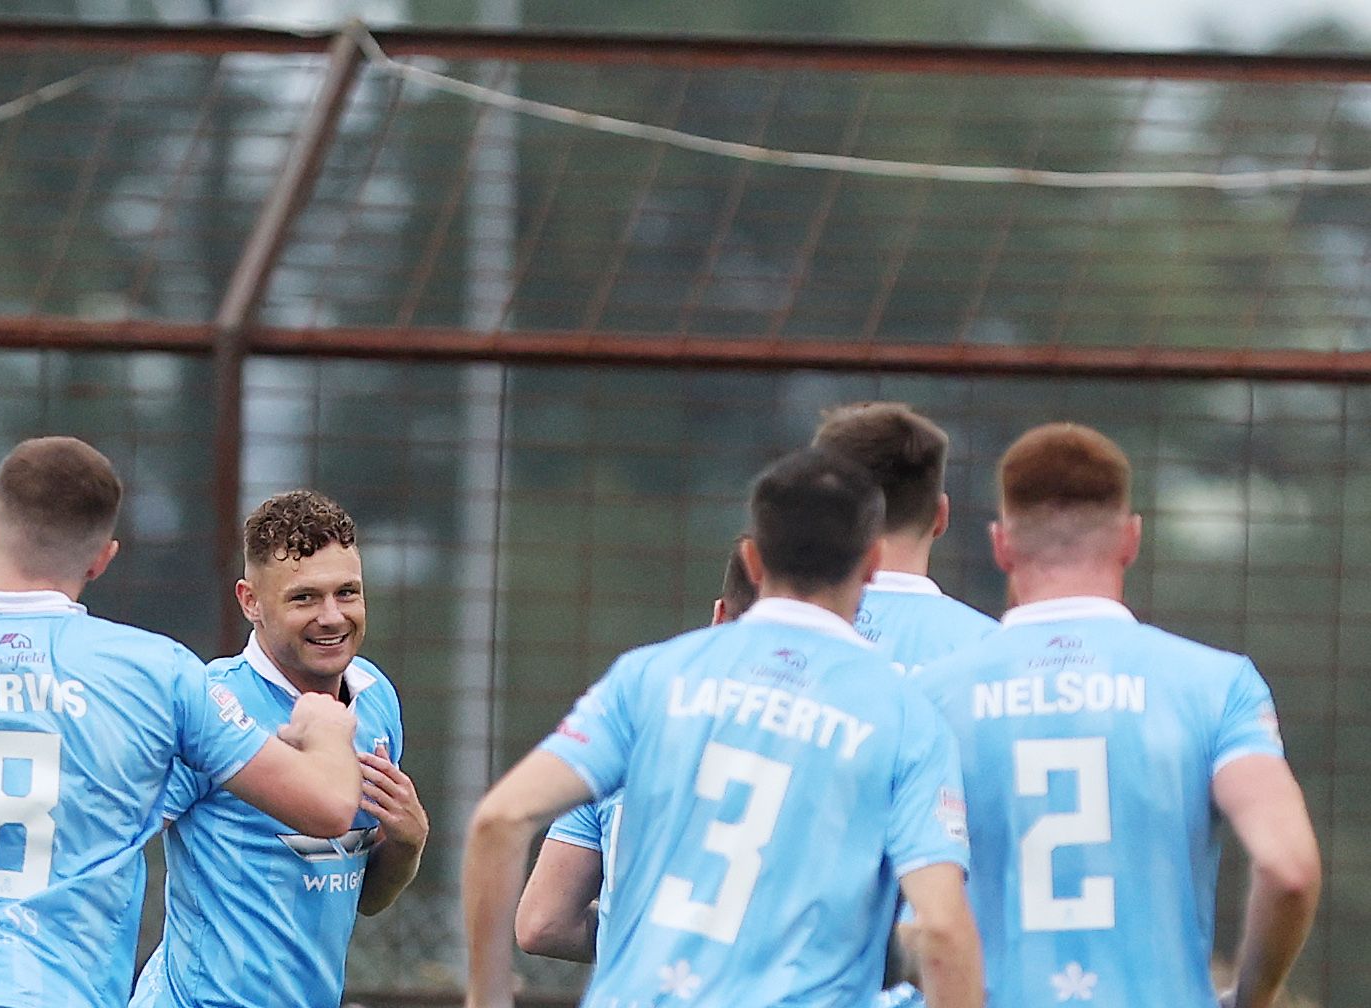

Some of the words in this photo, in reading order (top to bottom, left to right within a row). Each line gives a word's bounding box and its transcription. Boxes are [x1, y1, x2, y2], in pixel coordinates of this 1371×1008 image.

[667, 676, 875, 761] LAFFERTY
[973, 671, 1146, 721] NELSON
[649, 740, 793, 945] 3
[1012, 736, 1116, 931] 2
